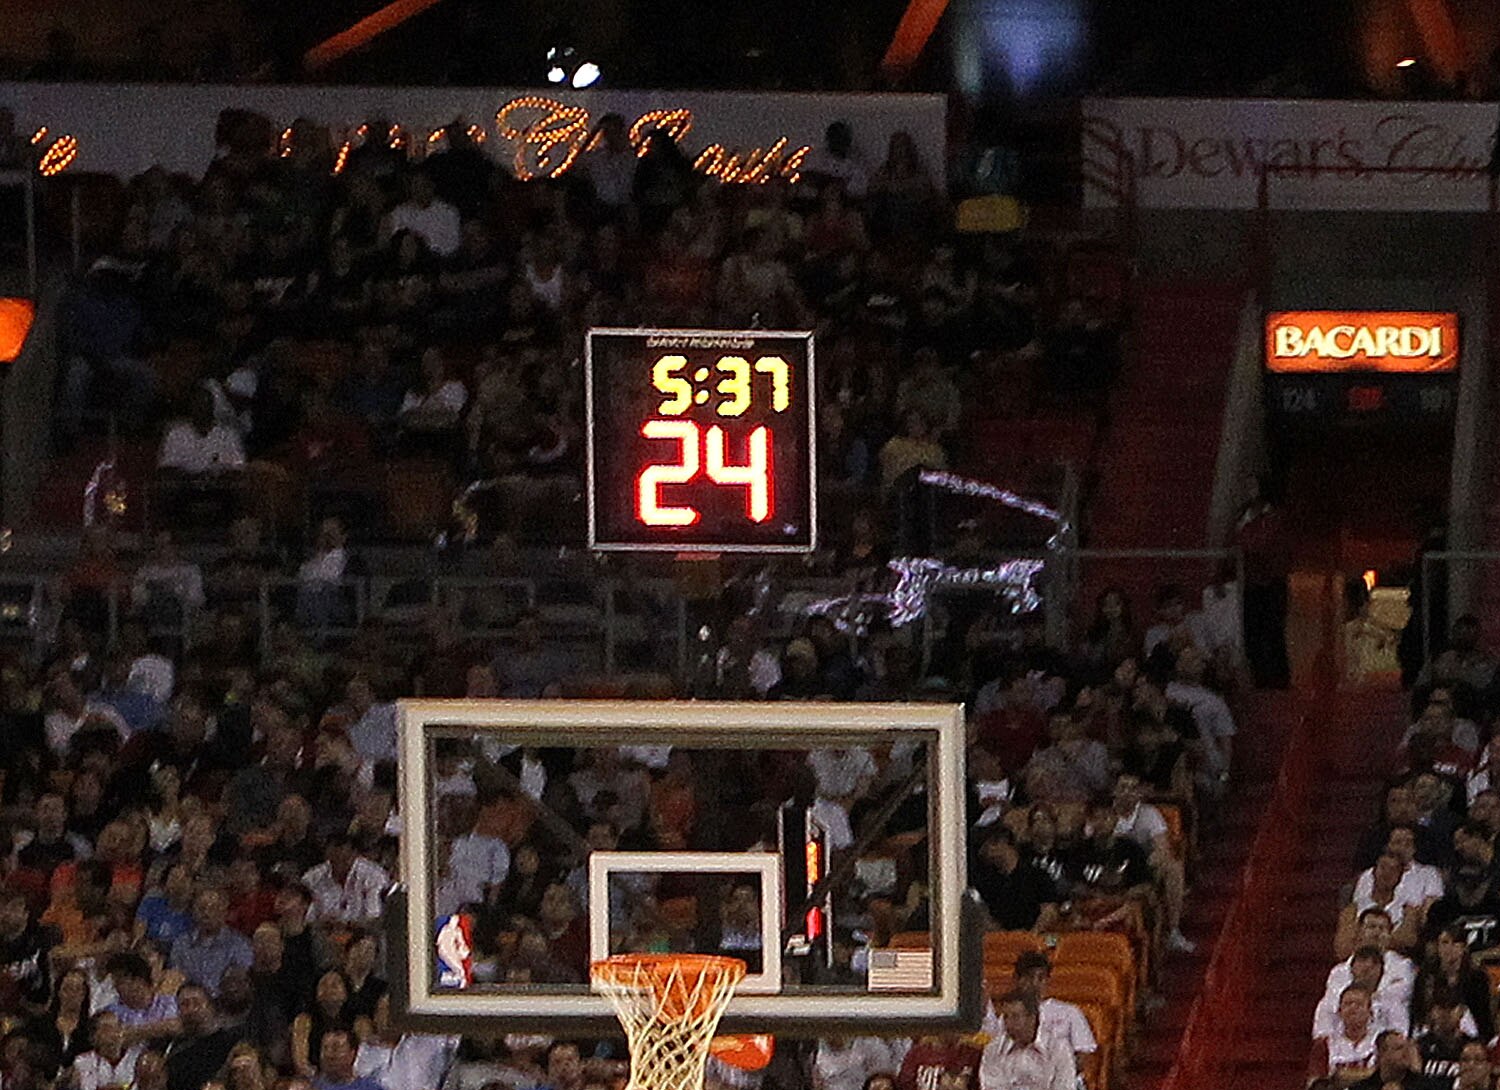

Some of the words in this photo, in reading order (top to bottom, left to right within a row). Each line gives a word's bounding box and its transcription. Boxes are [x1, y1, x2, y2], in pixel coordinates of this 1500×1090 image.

[1275, 325, 1443, 358] BACARDI
[651, 354, 790, 416] 5:37
[636, 418, 771, 527] 24
